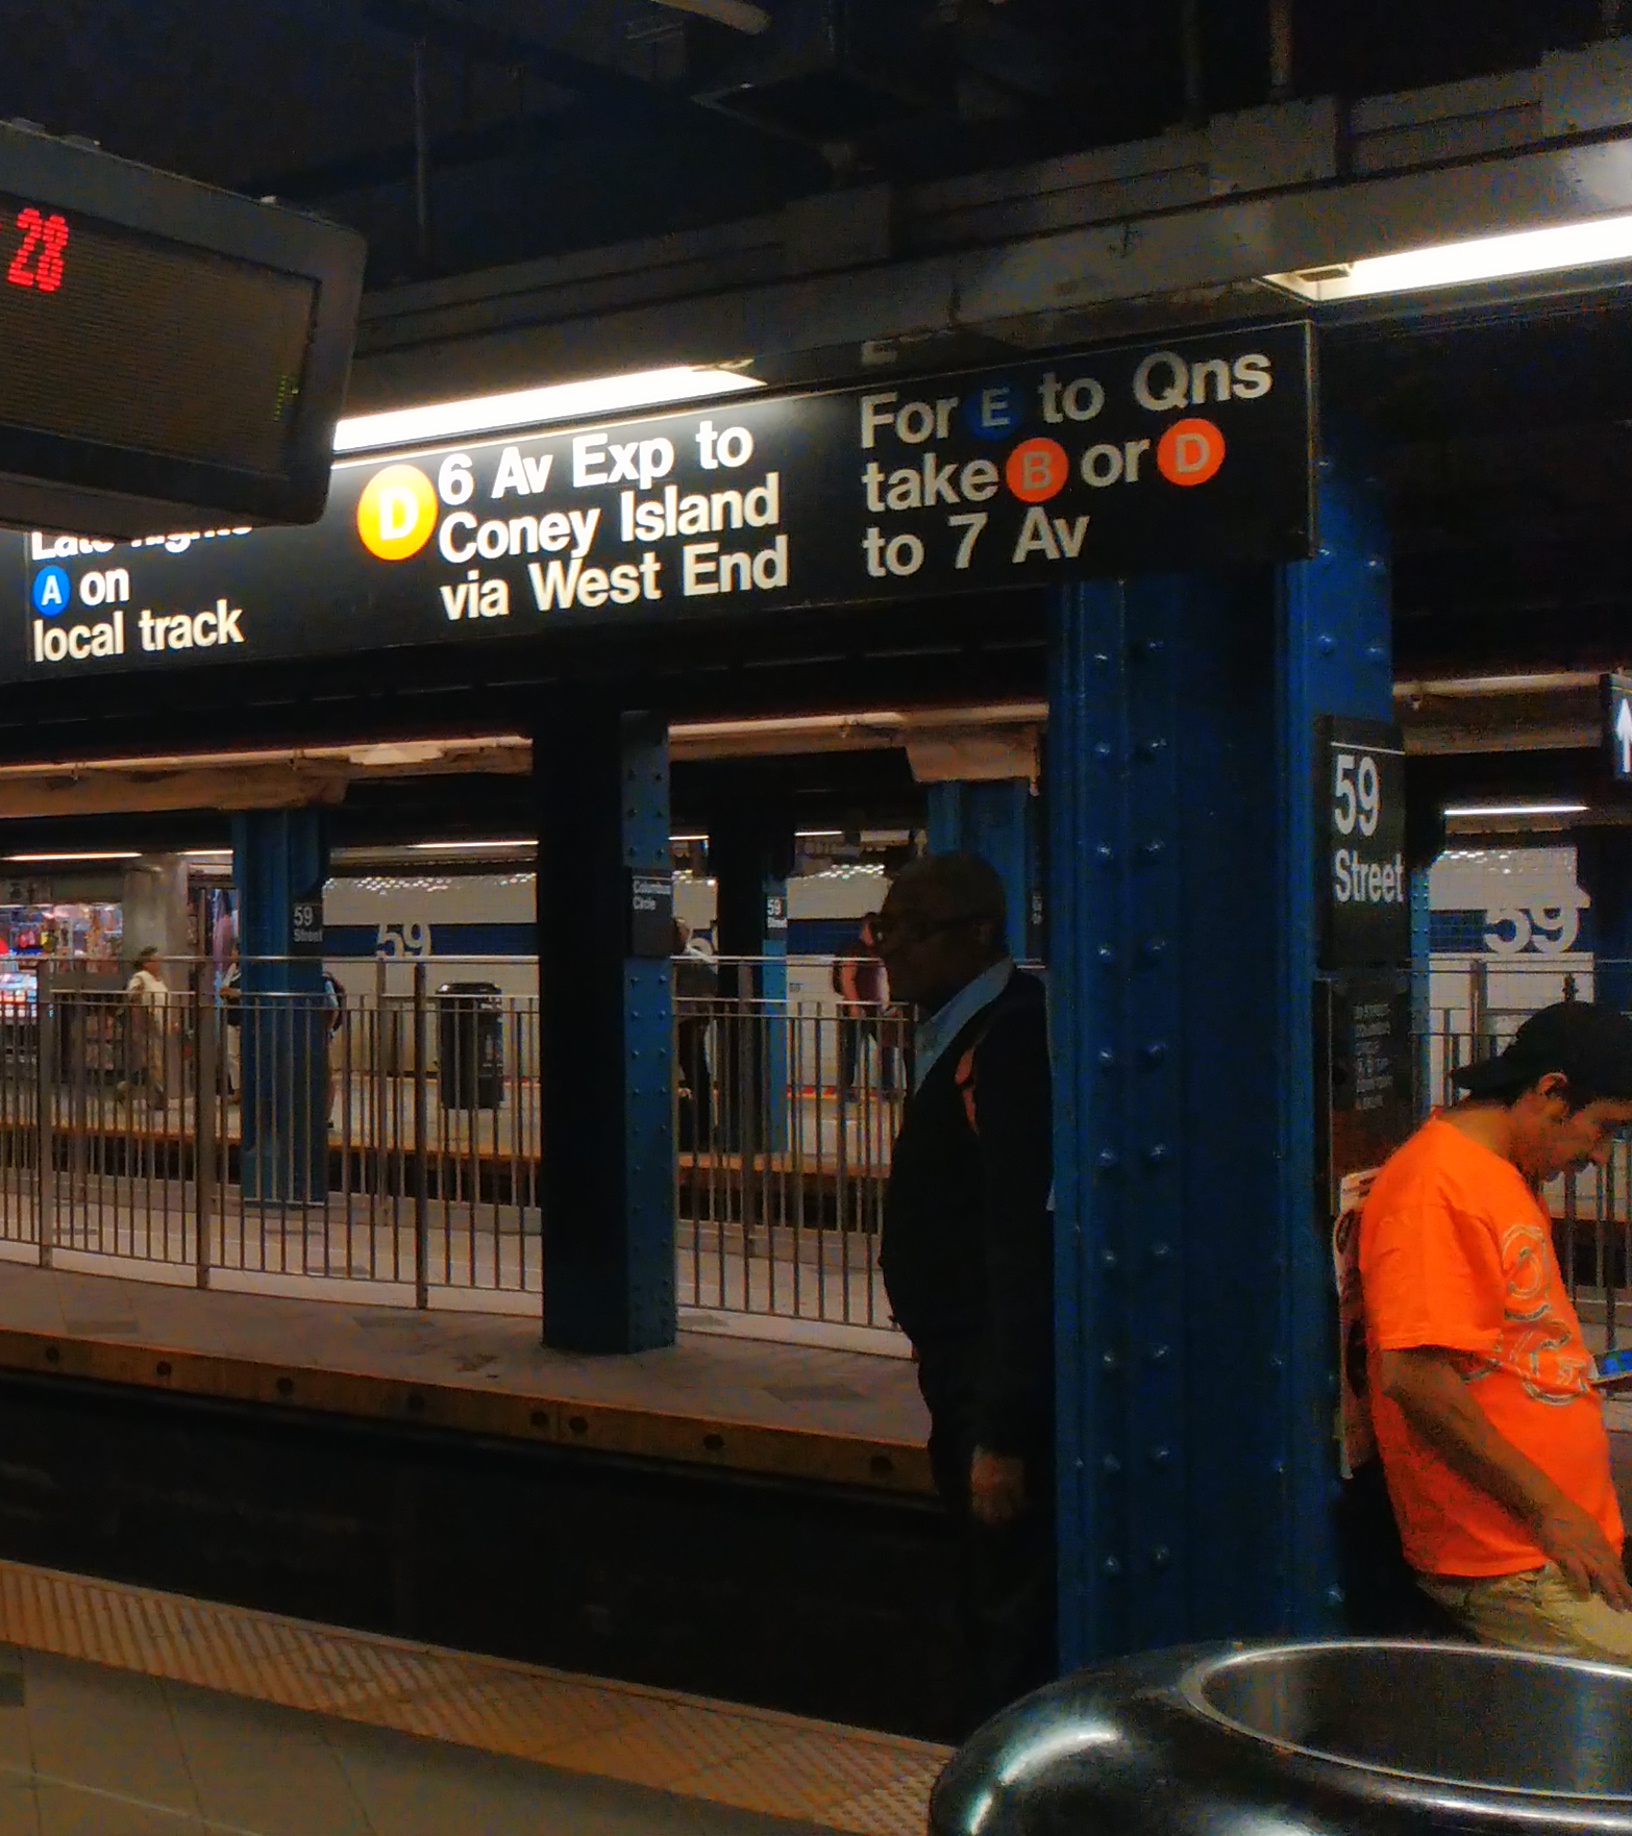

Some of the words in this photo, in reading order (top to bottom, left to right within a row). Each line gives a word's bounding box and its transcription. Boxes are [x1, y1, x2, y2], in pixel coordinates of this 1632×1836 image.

[8, 209, 69, 291] 28
[860, 392, 958, 449] For
[980, 386, 1011, 428] E
[1037, 371, 1105, 424] to
[1132, 350, 1273, 411] Qns
[438, 453, 475, 506] 6
[491, 446, 554, 499] Av
[572, 433, 675, 490] Exp
[695, 420, 754, 470] to
[861, 452, 1000, 513] take
[1021, 451, 1053, 491] B
[1080, 438, 1151, 488] or
[1174, 433, 1210, 474] D
[378, 487, 419, 541] D
[439, 508, 601, 564] Coney
[620, 472, 780, 543] Island
[861, 526, 925, 578] to
[947, 511, 989, 570] 7
[1011, 506, 1089, 564] Av
[41, 574, 62, 606] A
[79, 568, 130, 607] on
[440, 570, 510, 622] via
[528, 551, 662, 612] West
[682, 534, 789, 598] End
[33, 610, 125, 663] local
[139, 599, 245, 652] track
[1334, 754, 1380, 836] 59
[767, 899, 781, 915] 59
[1334, 849, 1405, 902] Street
[293, 906, 313, 926] 59
[376, 922, 432, 958] 59
[1484, 905, 1579, 953] 59
